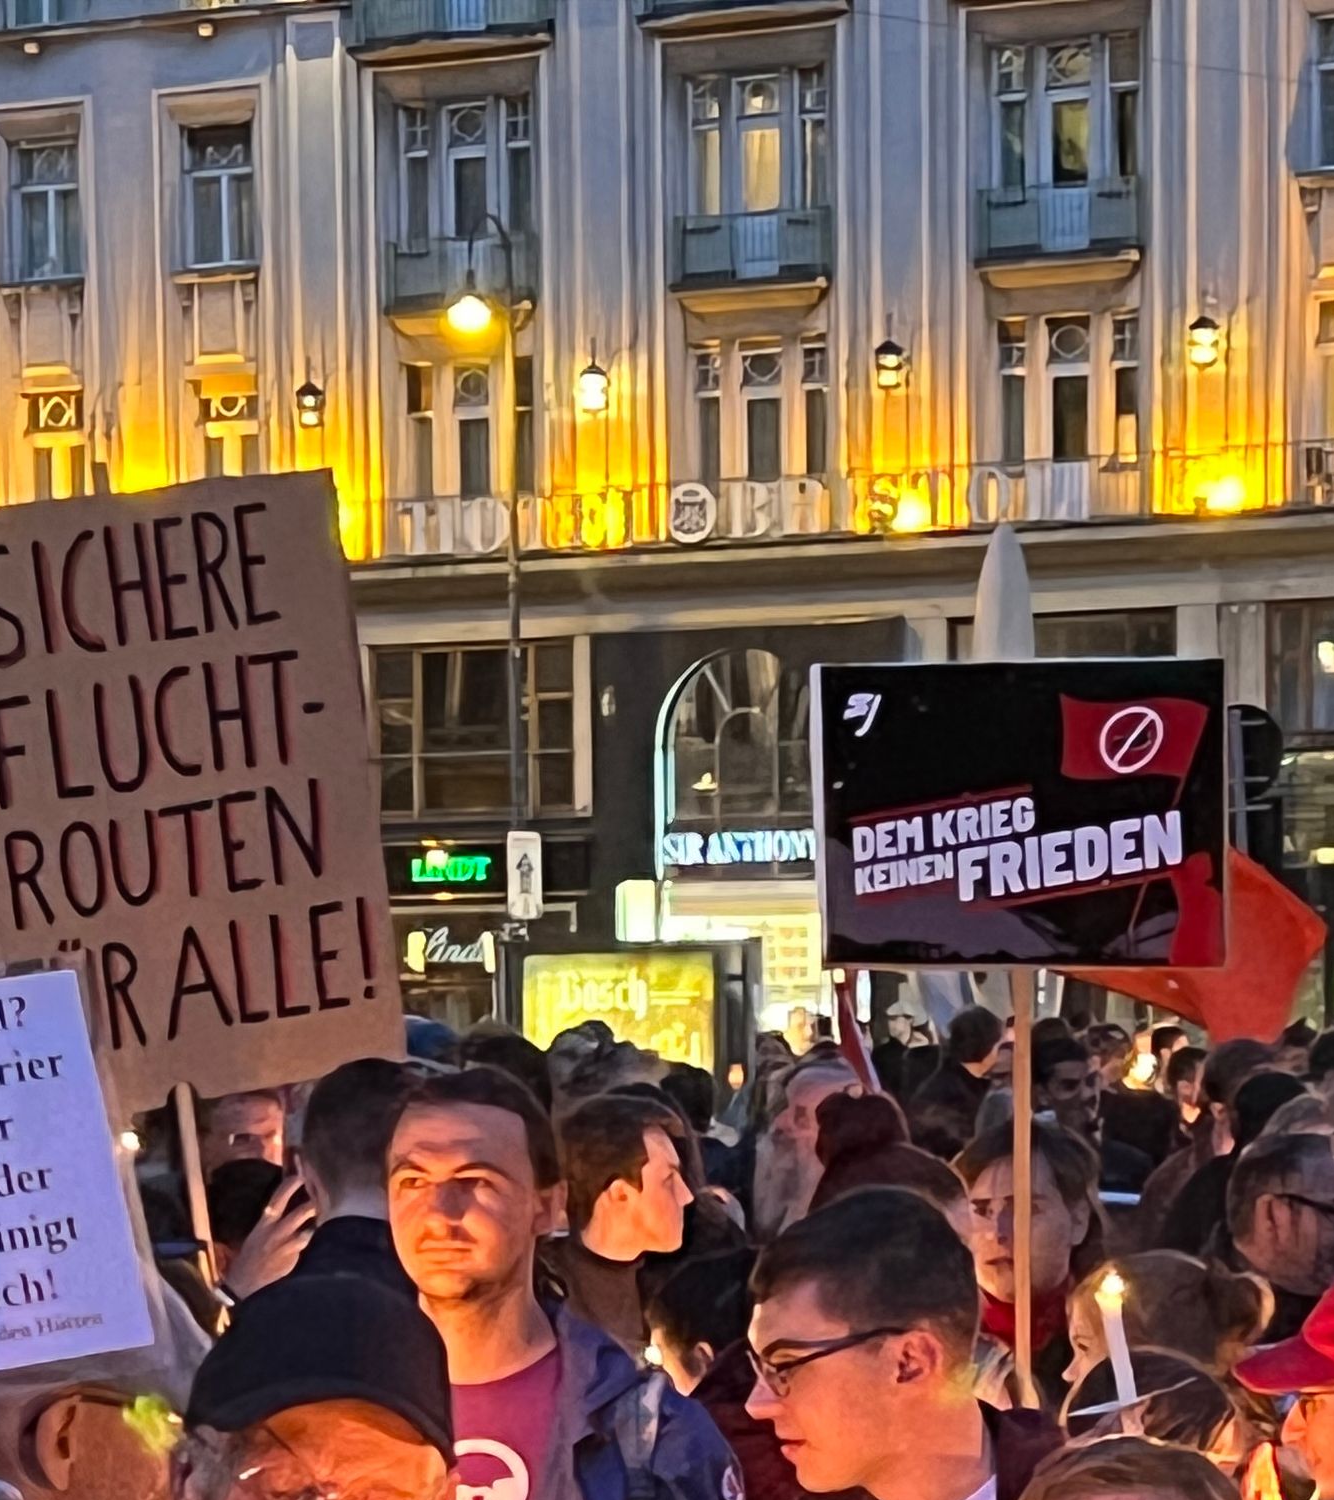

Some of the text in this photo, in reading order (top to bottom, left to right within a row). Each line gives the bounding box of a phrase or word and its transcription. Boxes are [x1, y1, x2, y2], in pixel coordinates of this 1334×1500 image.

[4, 778, 324, 931] ROUTEN
[663, 832, 705, 865] SIR
[852, 797, 1036, 863] DEM KRIEG
[854, 810, 1183, 902] KEINEN FRIEDEN
[167, 897, 377, 1041] ALLE!
